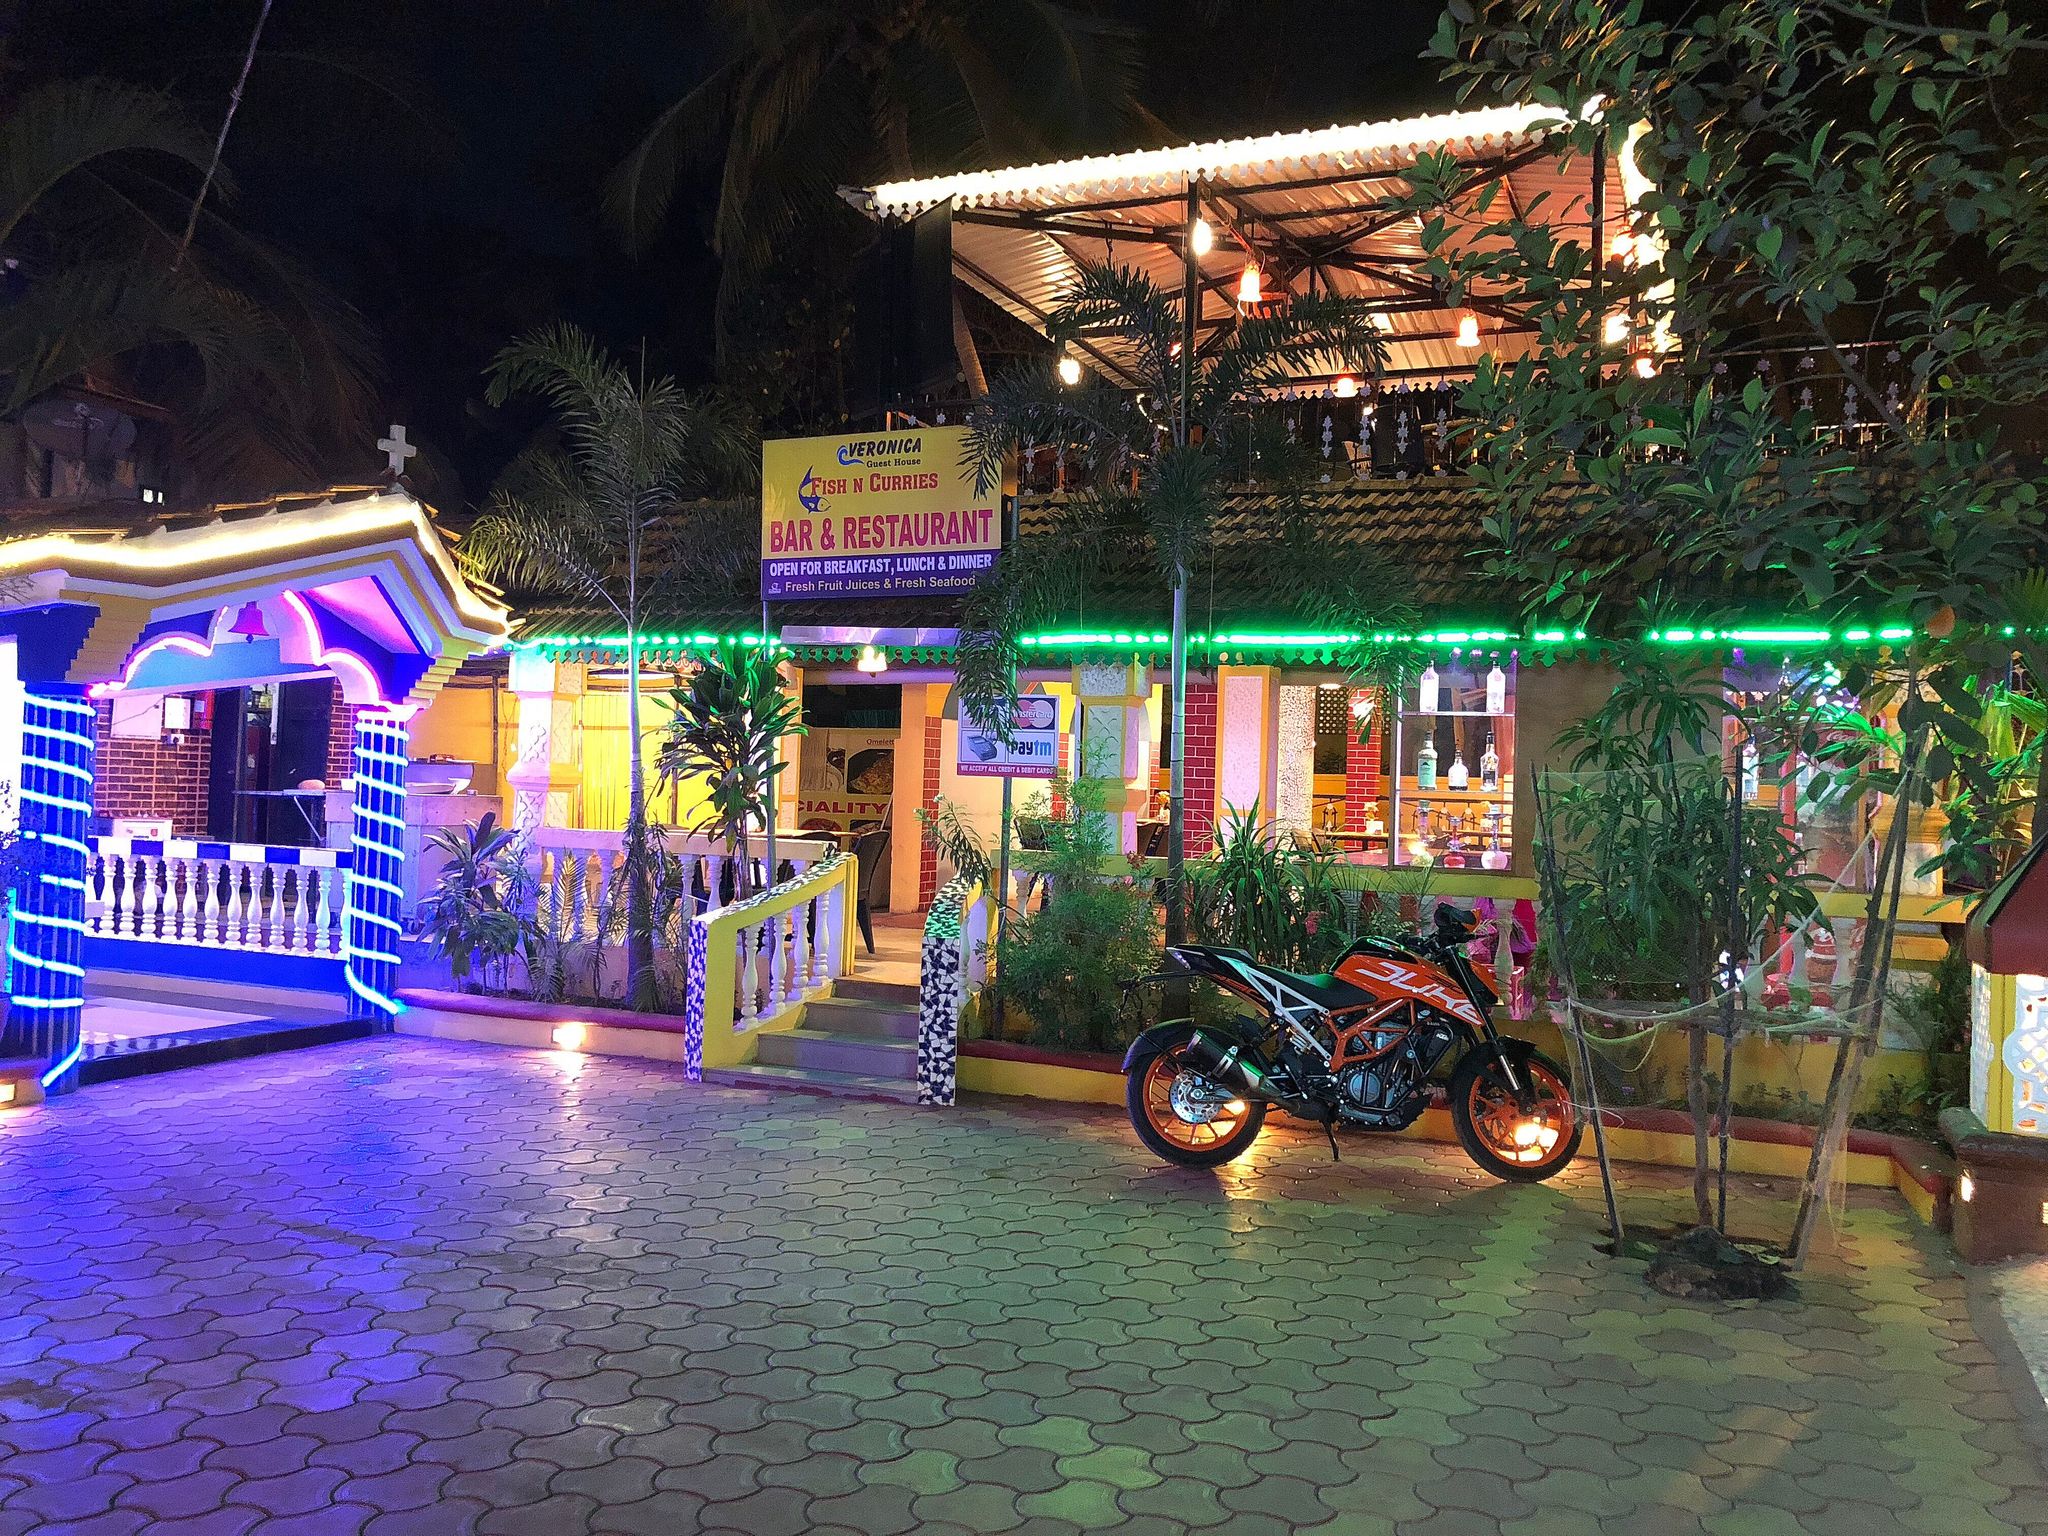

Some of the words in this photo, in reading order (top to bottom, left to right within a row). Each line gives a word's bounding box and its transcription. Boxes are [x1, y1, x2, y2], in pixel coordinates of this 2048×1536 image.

[849, 438, 921, 457] VERONICA
[866, 460, 891, 468] Guest
[894, 458, 921, 467] House
[870, 472, 938, 492] CURRIES
[770, 519, 813, 552] BAR
[820, 517, 835, 550] &
[843, 509, 993, 549] RESTAURANT
[770, 562, 798, 576] OPEN
[801, 561, 822, 575] FOR
[824, 558, 895, 576] BREAKFAST,
[896, 556, 935, 572] LUNCH
[938, 556, 946, 570] &
[949, 554, 992, 570] DINNER
[785, 581, 815, 592] Fresh
[818, 580, 842, 591] Fruit
[846, 579, 880, 590] Juices
[884, 578, 892, 589] &
[895, 577, 926, 588] Fresh
[929, 575, 976, 588] Seafood
